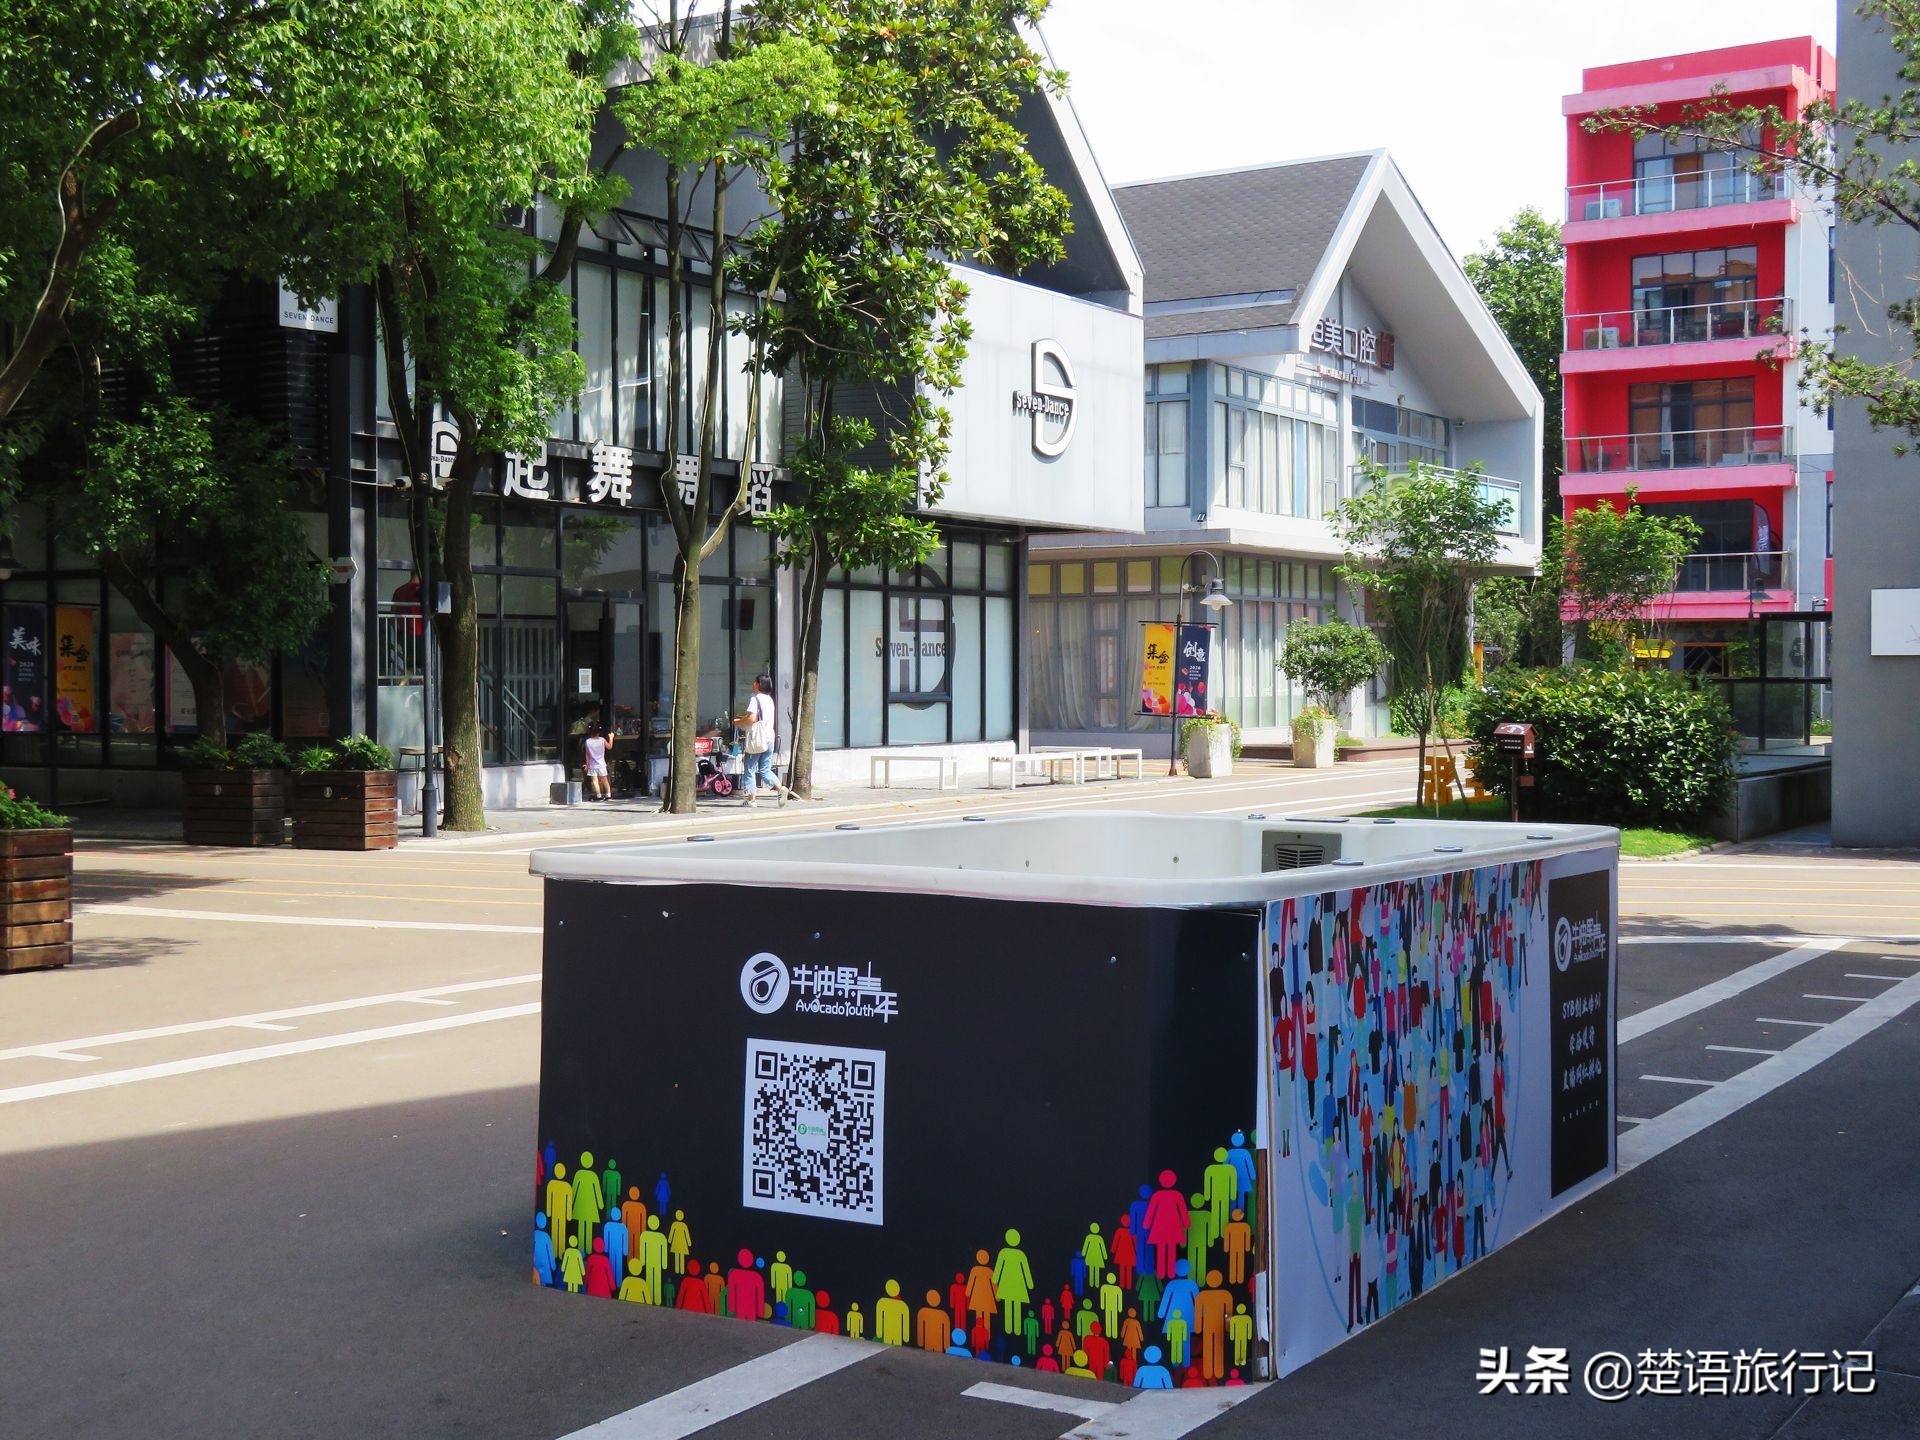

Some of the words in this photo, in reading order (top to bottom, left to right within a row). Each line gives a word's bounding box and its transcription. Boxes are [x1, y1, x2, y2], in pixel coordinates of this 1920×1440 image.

[284, 311, 307, 320] SEVEN
[310, 314, 334, 324] DANCE
[1013, 389, 1070, 416] Seven-Dance
[10, 626, 41, 655] 美味
[875, 636, 946, 658] Sven-ance
[1183, 641, 1206, 662] 创意
[791, 961, 899, 1024] 牛油果青年
